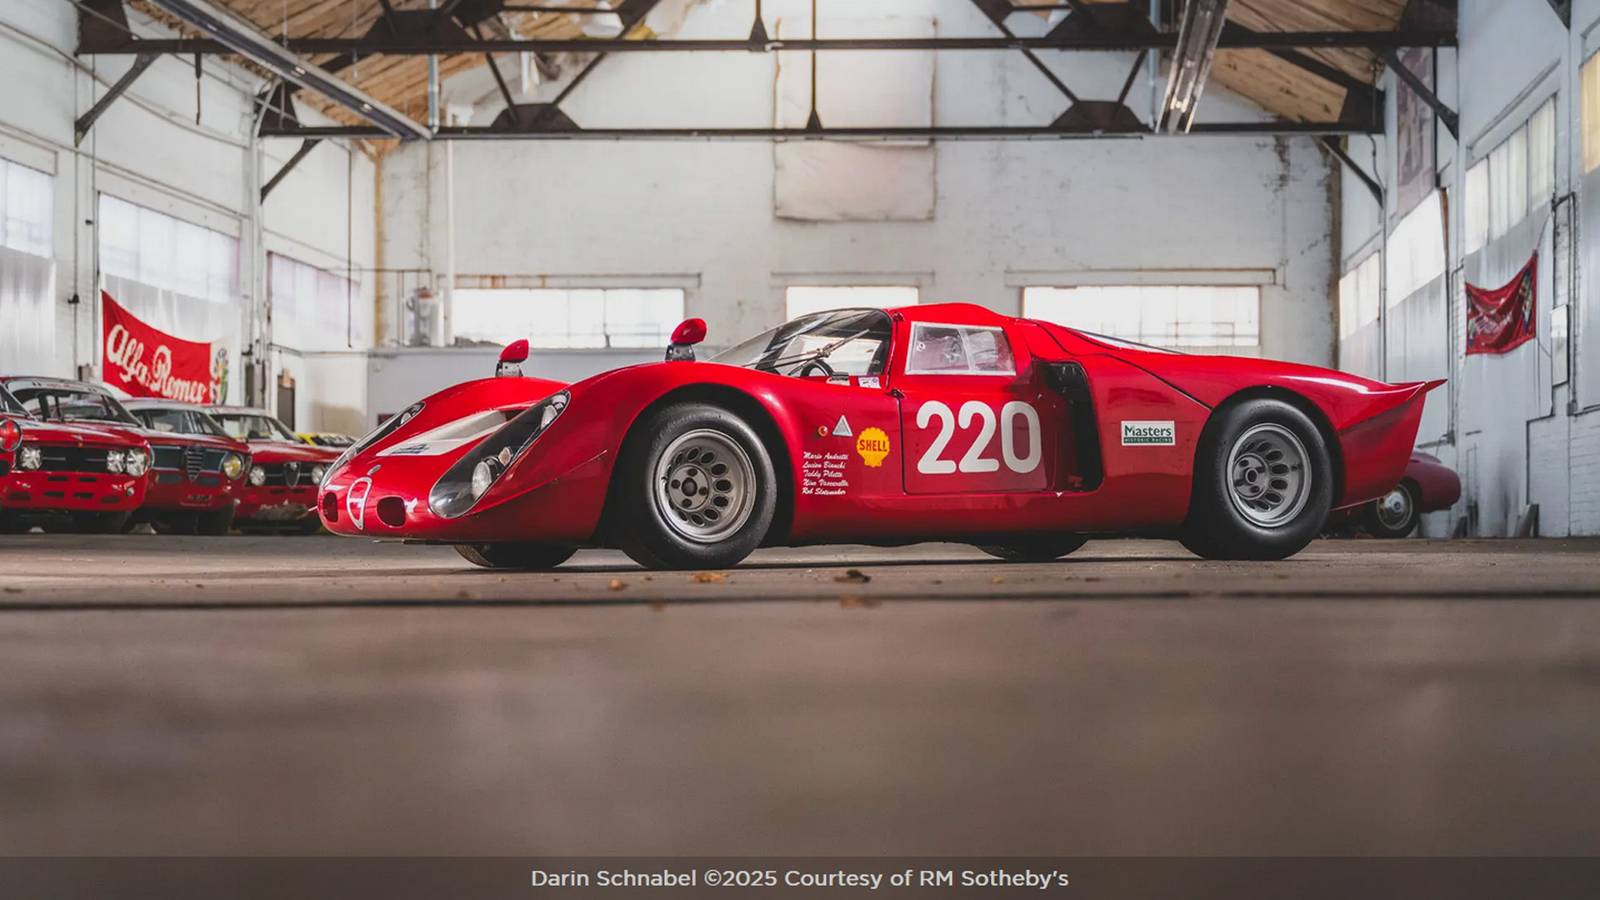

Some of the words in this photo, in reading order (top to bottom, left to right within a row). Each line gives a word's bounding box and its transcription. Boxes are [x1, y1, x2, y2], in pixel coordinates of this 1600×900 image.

[106, 324, 149, 386] Alfa
[916, 400, 1042, 474] 220
[1124, 424, 1172, 437] Masters
[859, 439, 888, 452] SHELL
[803, 451, 822, 460] Mario
[803, 469, 822, 478] Teddy
[801, 486, 814, 495] Rob
